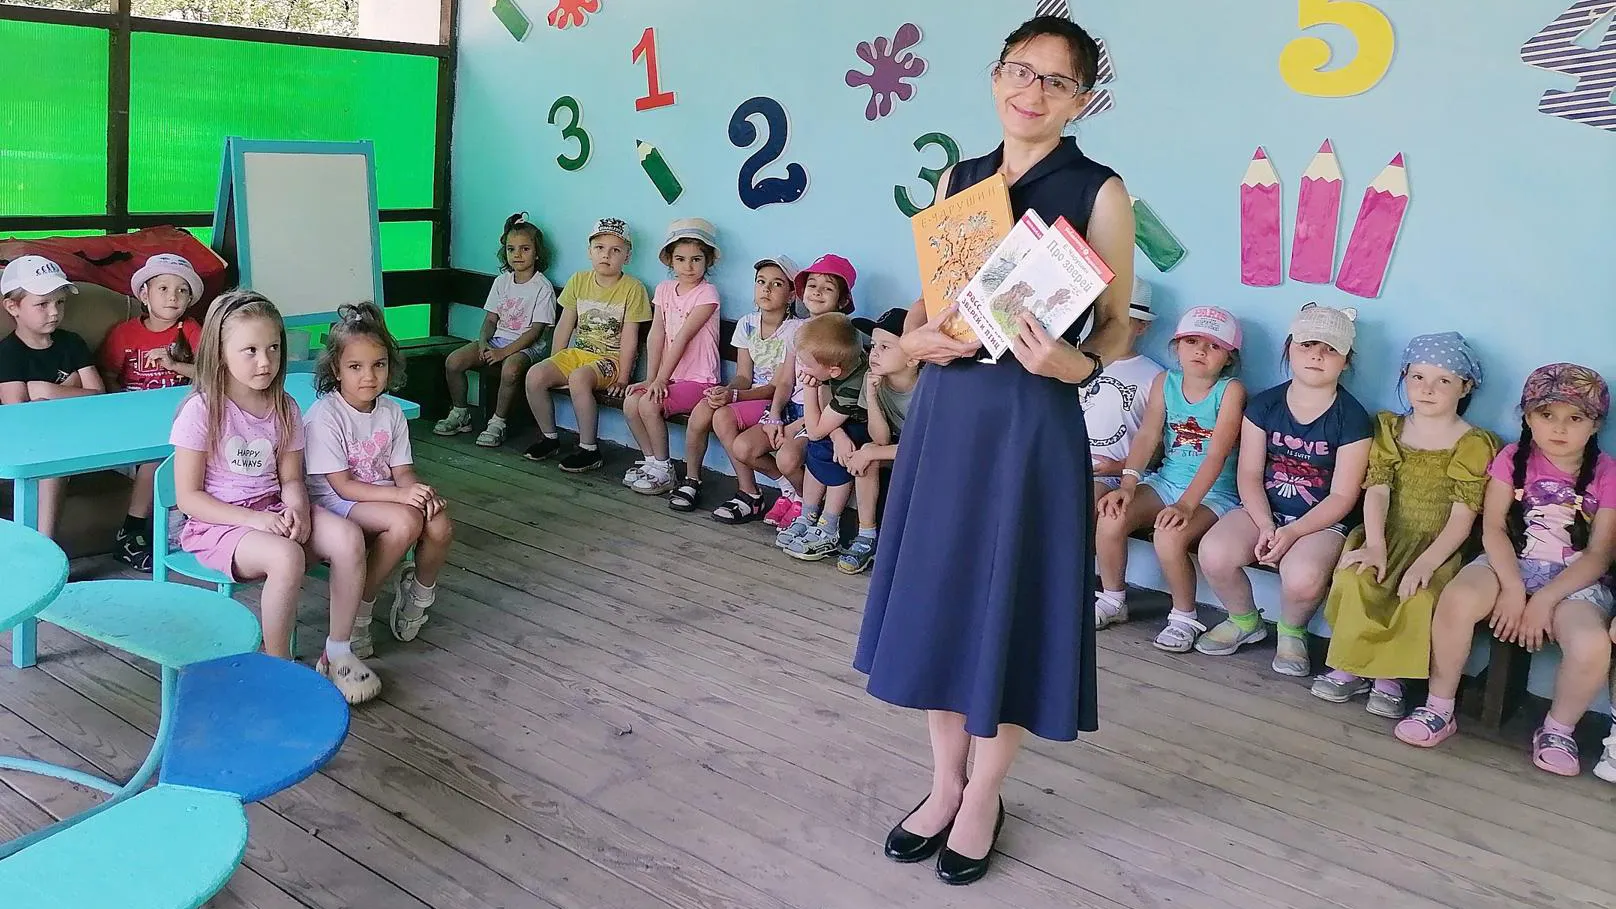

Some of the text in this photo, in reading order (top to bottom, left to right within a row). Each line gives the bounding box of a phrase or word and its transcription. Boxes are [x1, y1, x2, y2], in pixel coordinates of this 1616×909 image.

[632, 27, 676, 112] 1
[1279, 0, 1395, 97] 5
[547, 95, 592, 171] 3
[728, 96, 807, 209] 2
[894, 132, 961, 217] 3
[1046, 239, 1065, 262] Про
[1062, 259, 1094, 293] зверей
[231, 459, 263, 467] ALWAYS
[237, 449, 260, 457] HAPPY
